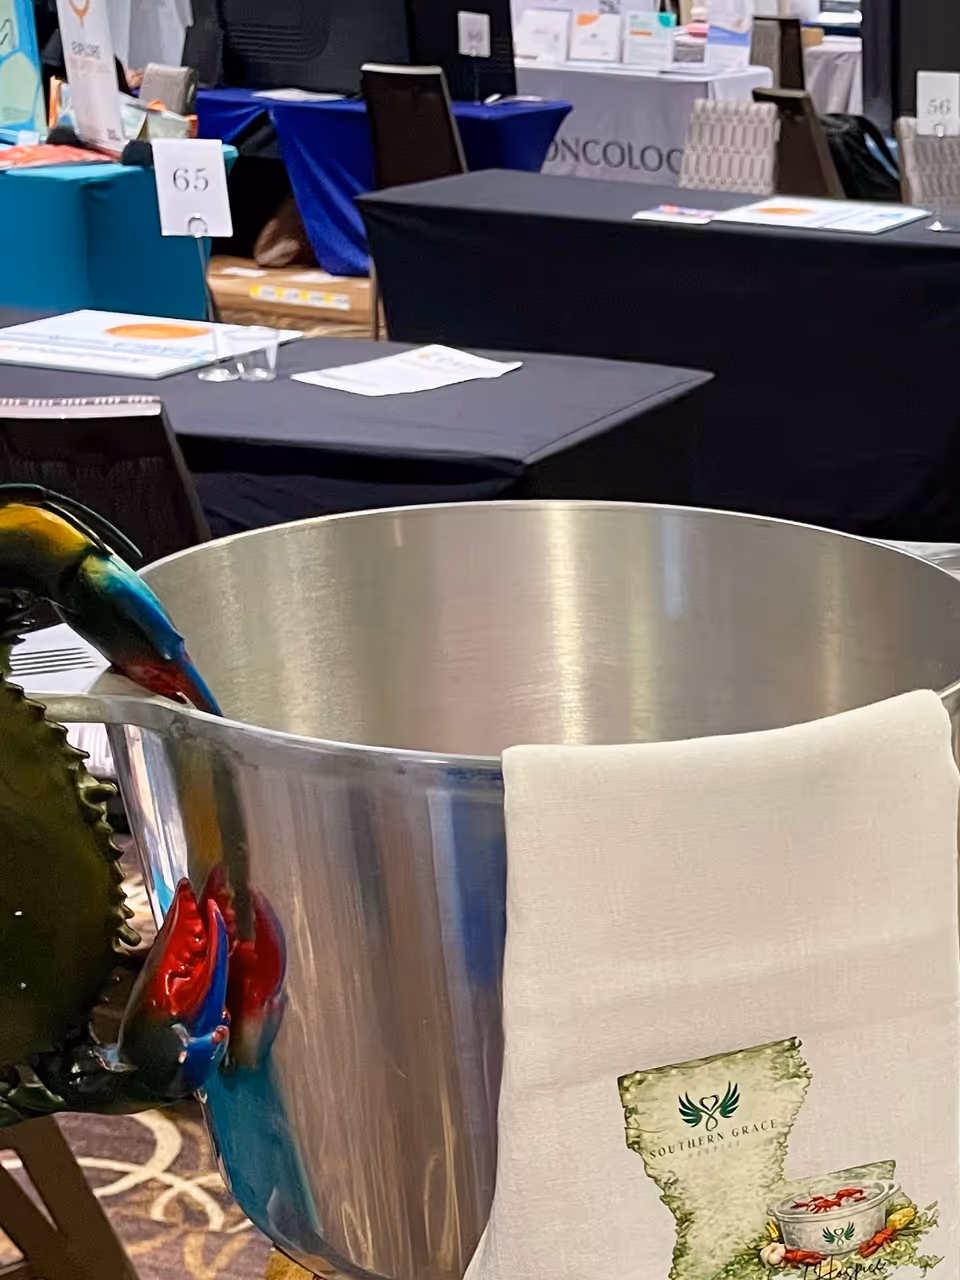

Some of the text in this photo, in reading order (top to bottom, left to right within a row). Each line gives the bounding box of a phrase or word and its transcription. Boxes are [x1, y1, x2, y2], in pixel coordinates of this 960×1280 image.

[173, 168, 209, 191] 65
[649, 1132, 724, 1159] SOUTHERN
[732, 1120, 778, 1137] GRACE
